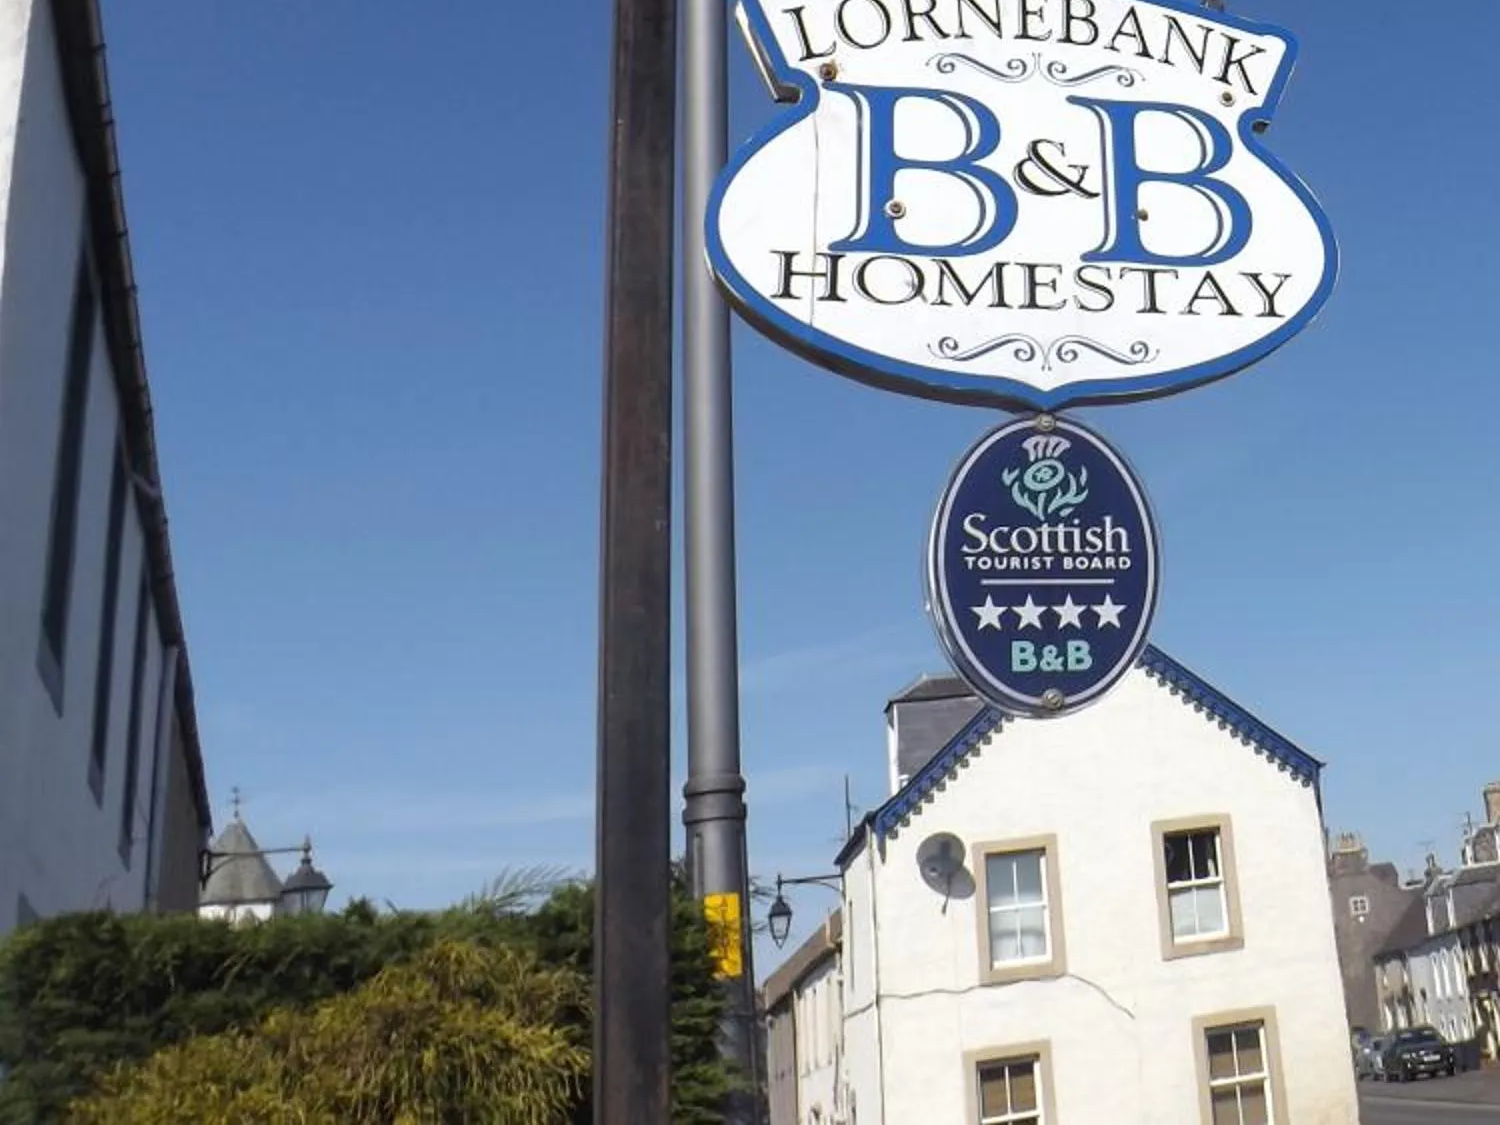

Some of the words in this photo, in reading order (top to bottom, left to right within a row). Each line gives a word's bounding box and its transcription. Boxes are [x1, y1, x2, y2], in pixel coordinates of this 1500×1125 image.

[821, 81, 1254, 266] B&B
[769, 249, 1292, 318] HOMESTAY
[960, 512, 1132, 554] Scottish
[963, 555, 1055, 571] TOURIST
[1062, 555, 1132, 571] BOARD
[1011, 639, 1093, 673] B&B
